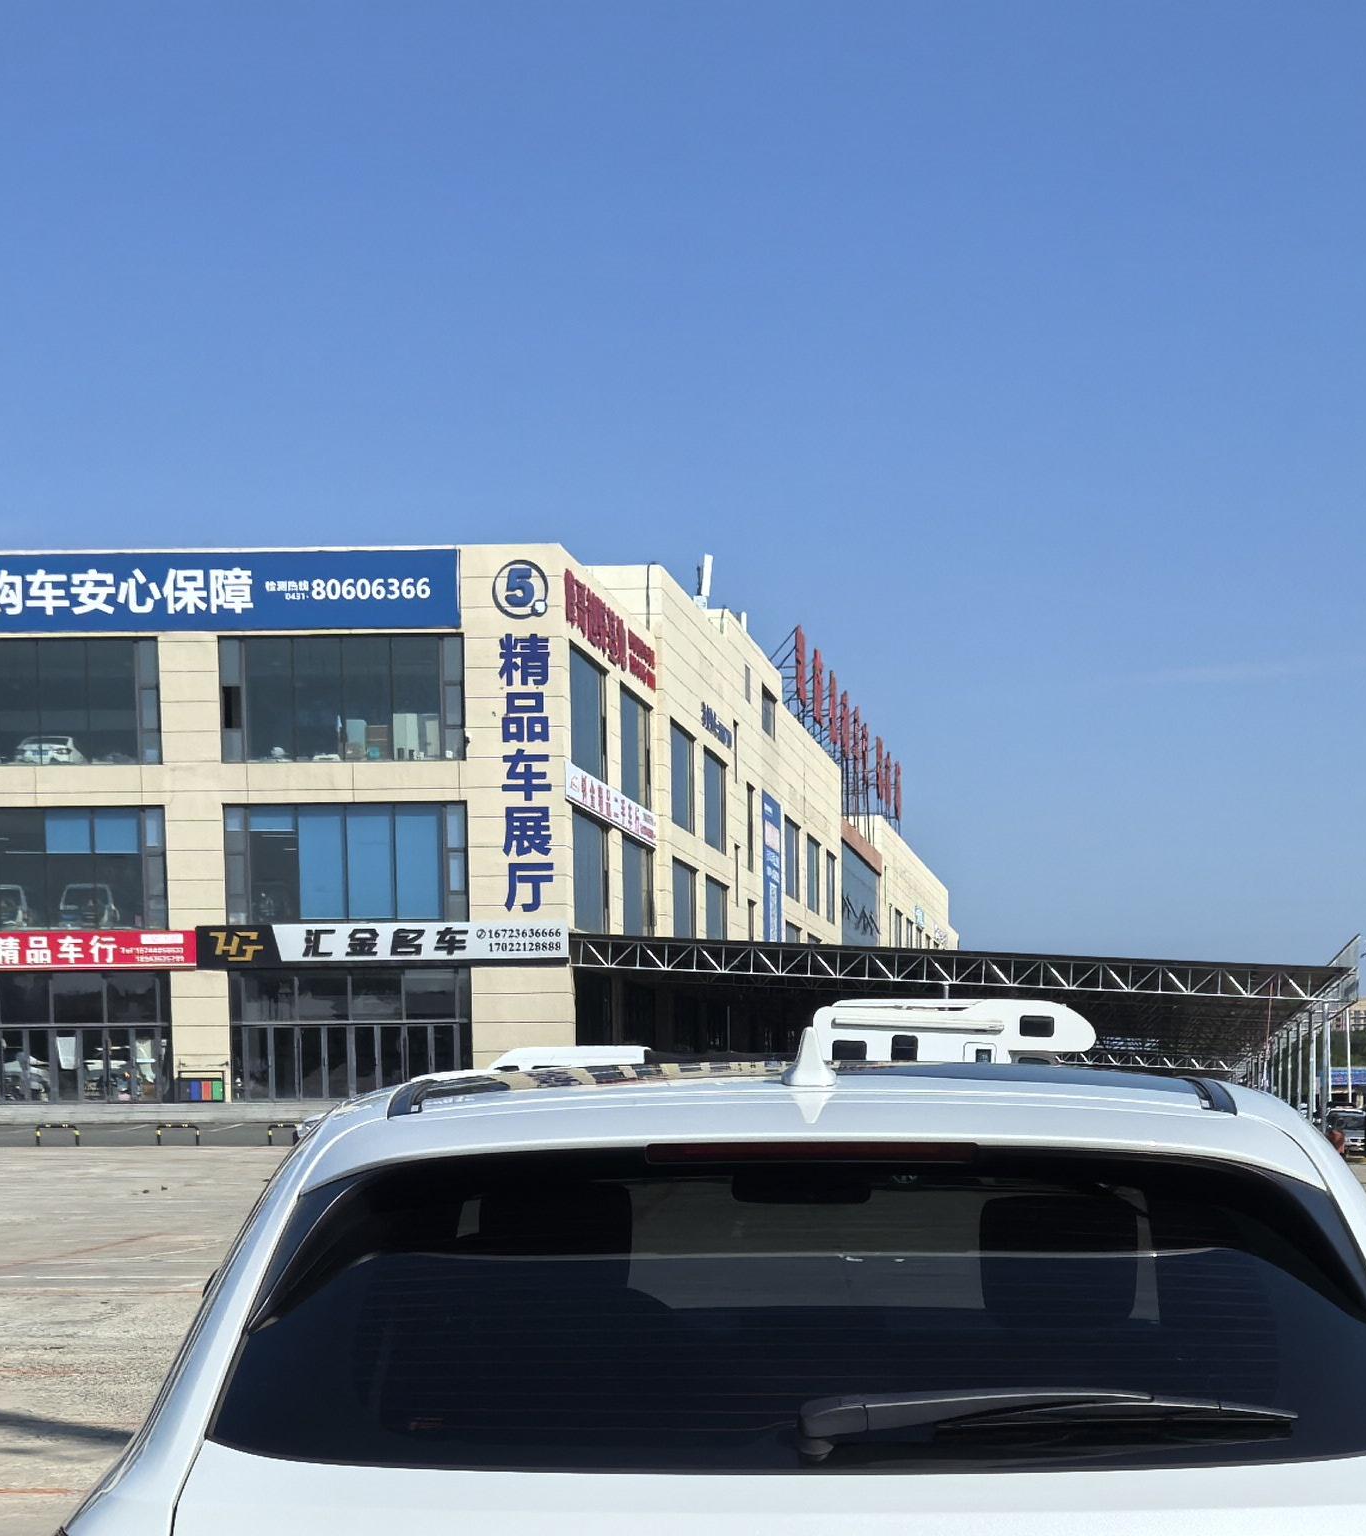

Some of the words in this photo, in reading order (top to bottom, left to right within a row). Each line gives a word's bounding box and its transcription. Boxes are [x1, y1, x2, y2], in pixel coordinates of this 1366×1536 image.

[311, 578, 431, 600] 80606366
[499, 633, 554, 912] 精品车展厅
[303, 927, 468, 957] 汇金名车
